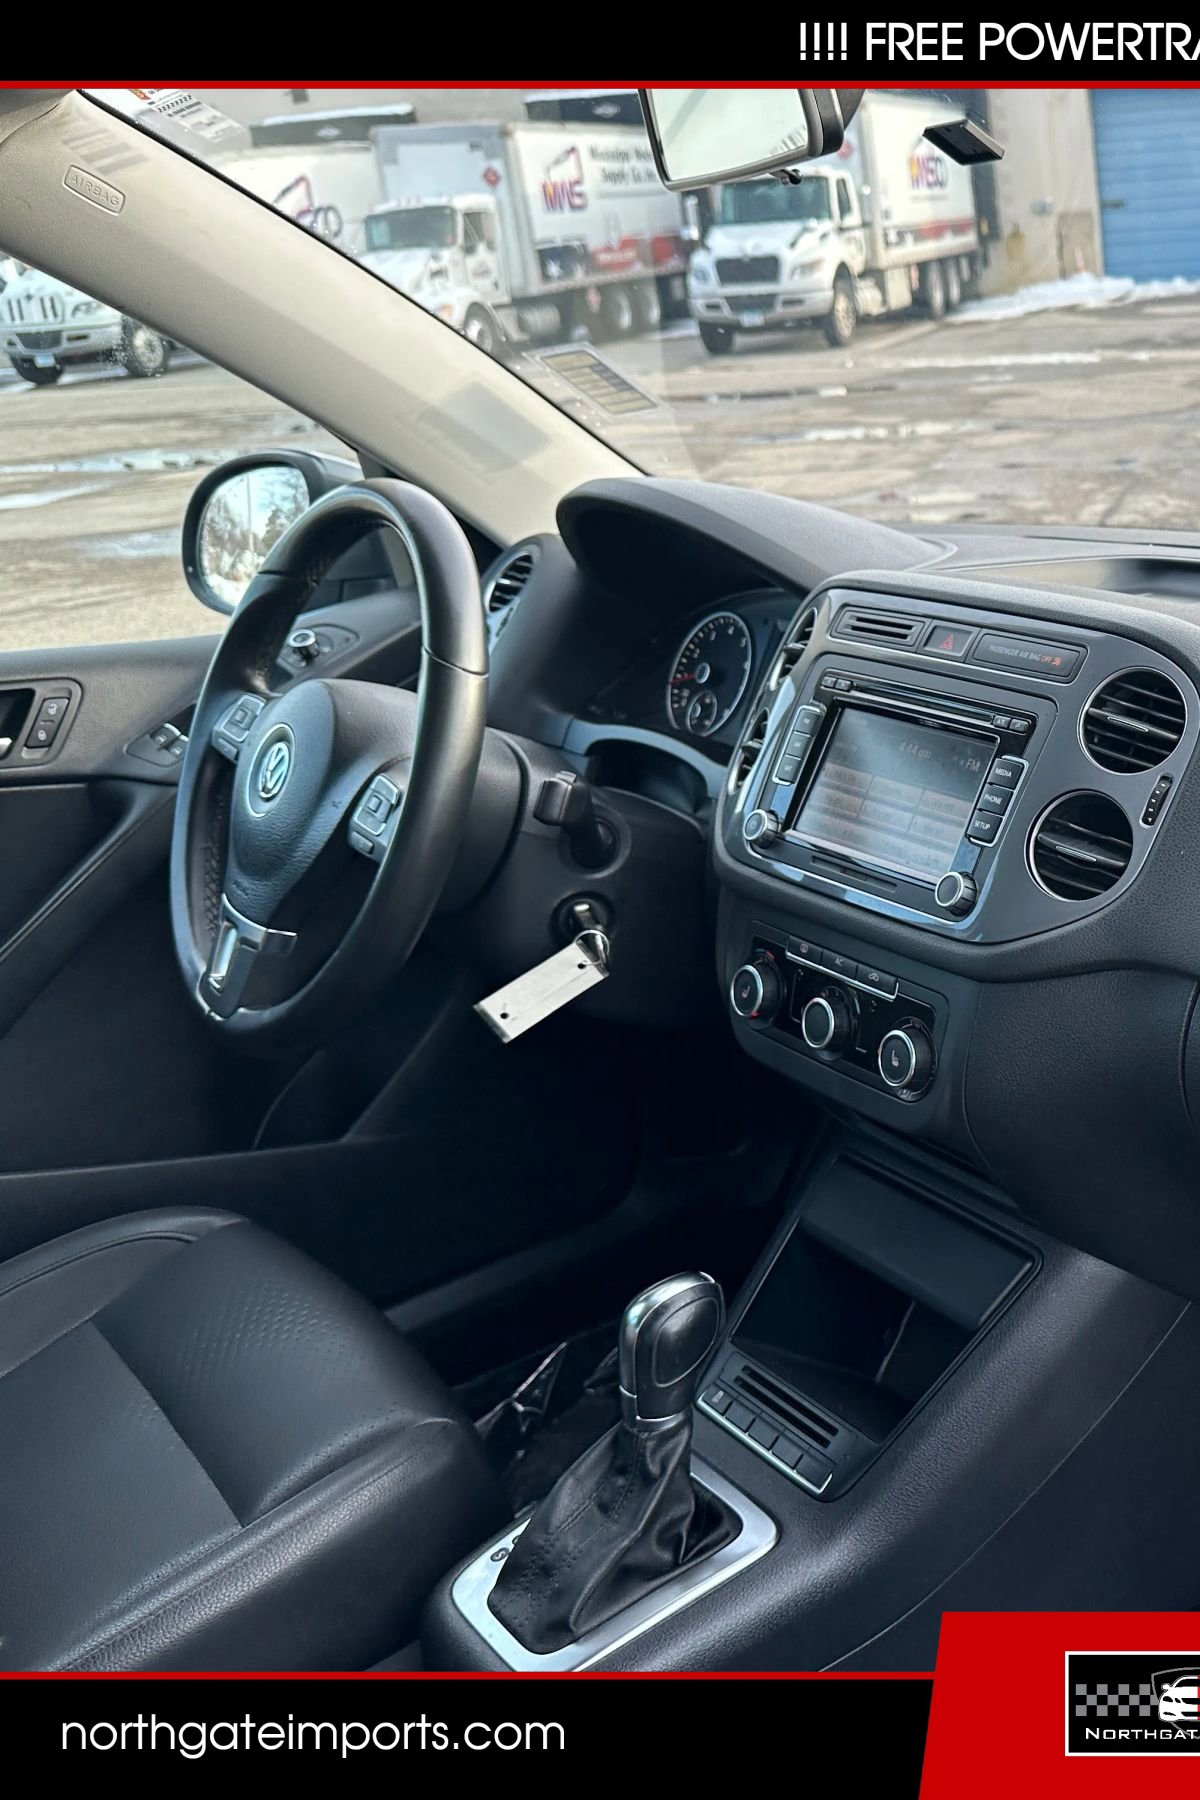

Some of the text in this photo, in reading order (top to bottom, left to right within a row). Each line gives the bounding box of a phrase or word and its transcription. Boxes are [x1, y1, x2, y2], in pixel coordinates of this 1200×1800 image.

[70, 174, 120, 207] AIRBAG
[988, 644, 1053, 663] PASSENGER AIR BAG OFF
[965, 757, 982, 773] FM
[994, 766, 1013, 778] MEDIA
[983, 793, 1003, 805] PHONE
[973, 820, 991, 831] SETUP
